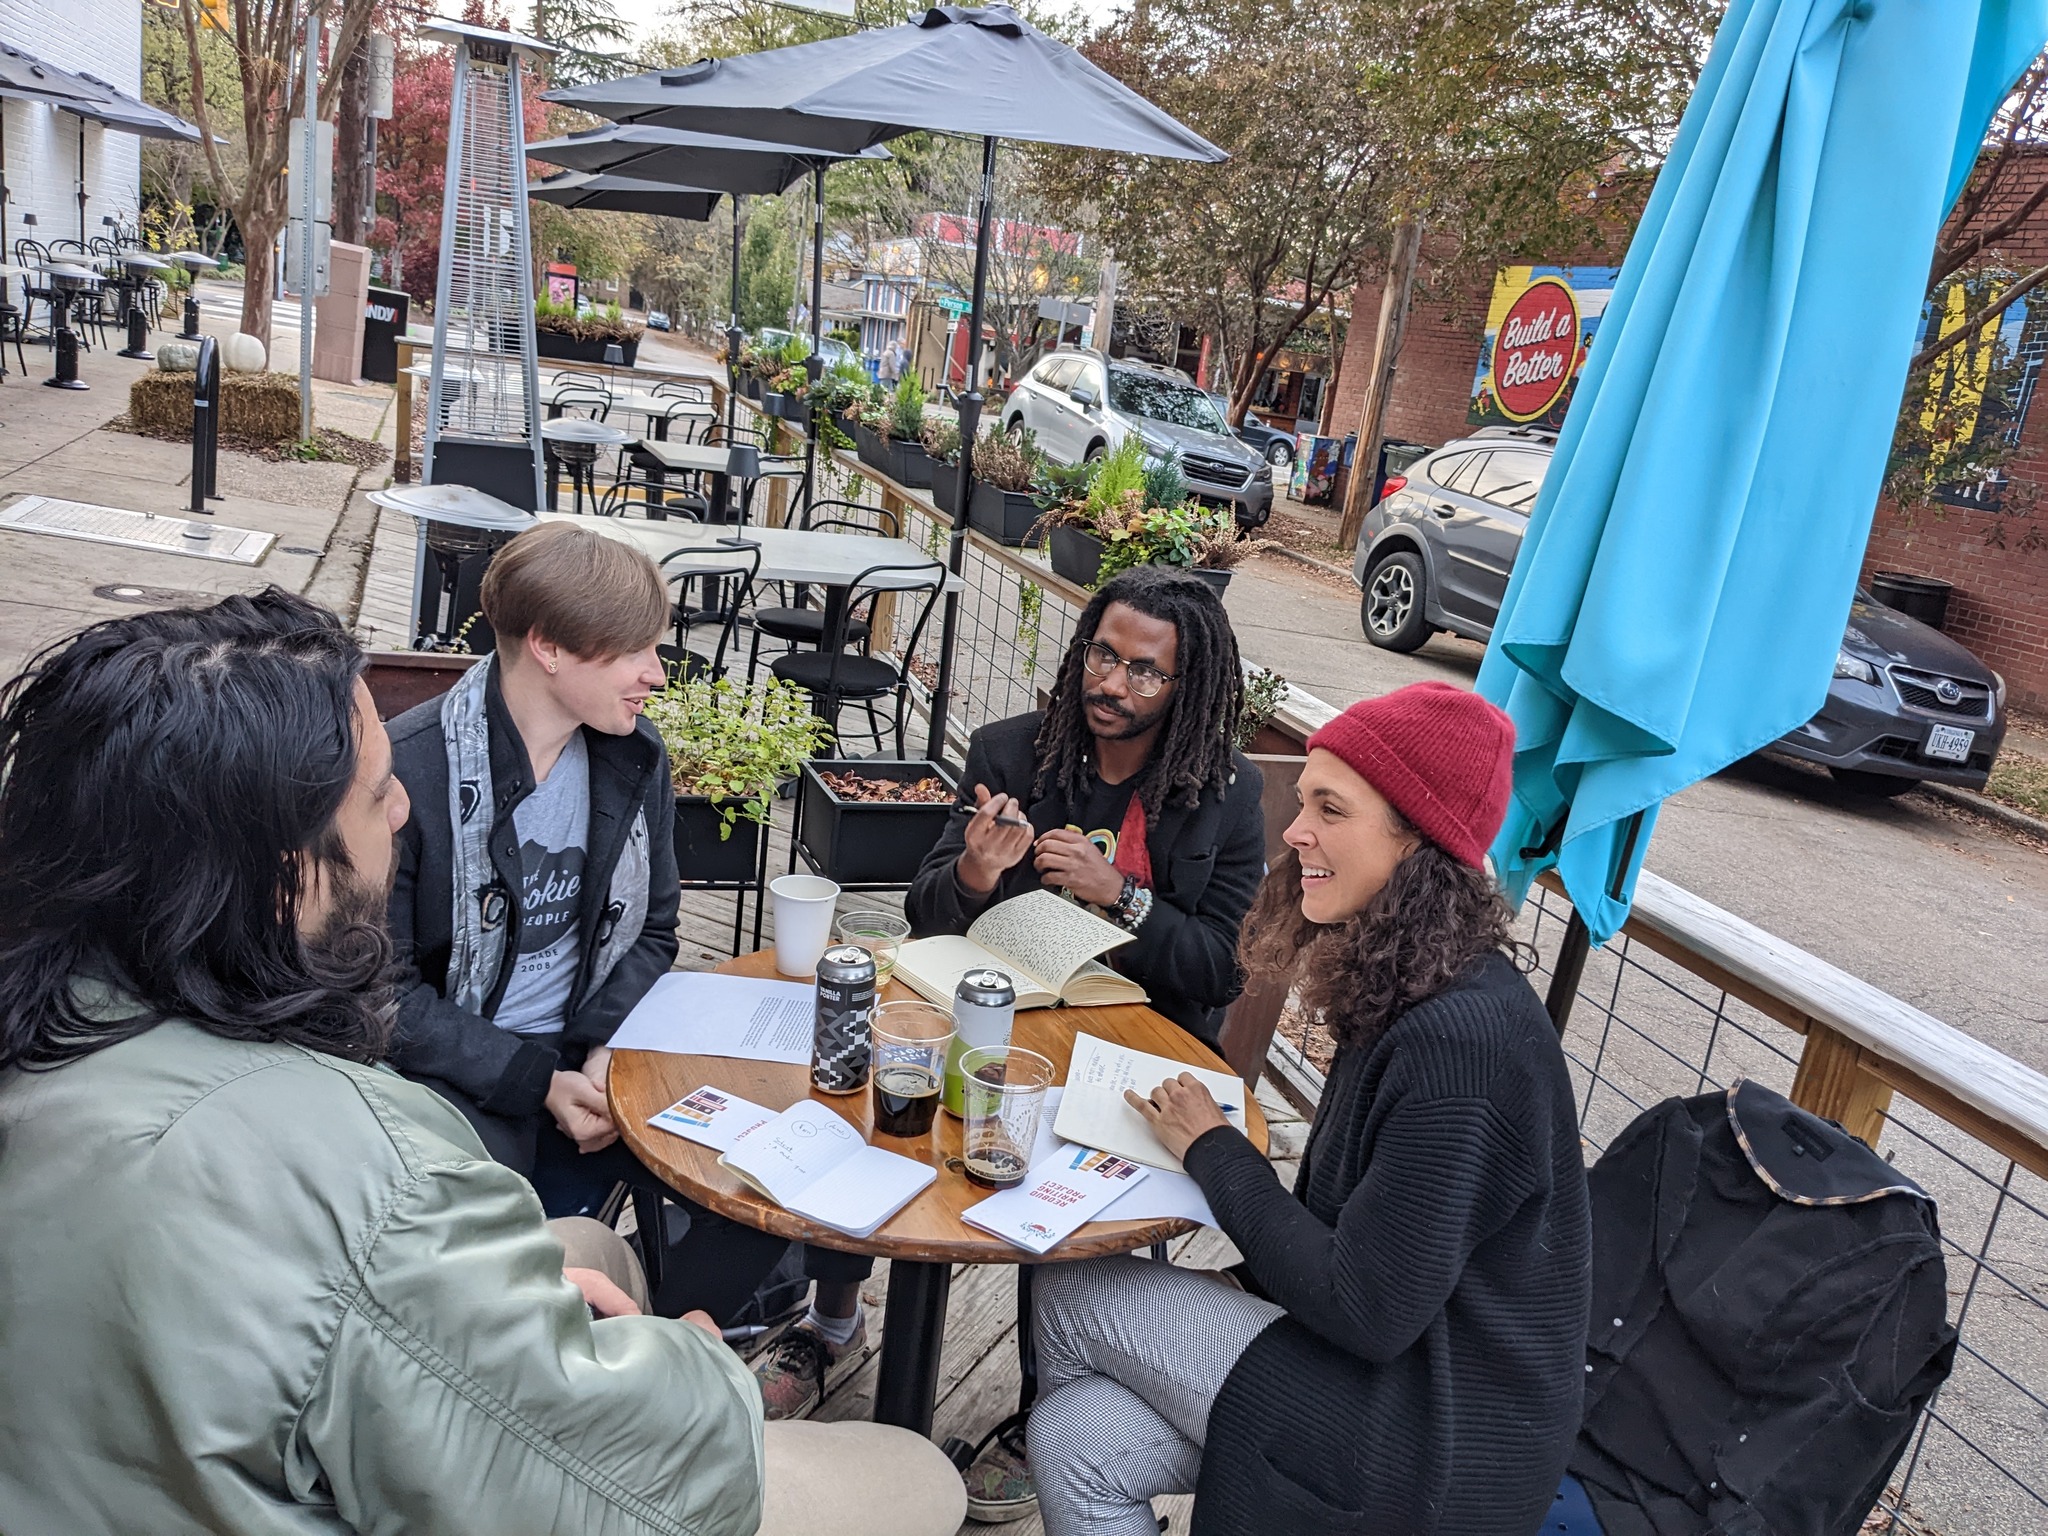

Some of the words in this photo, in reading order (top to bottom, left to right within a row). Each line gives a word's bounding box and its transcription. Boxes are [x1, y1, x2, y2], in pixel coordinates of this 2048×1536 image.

[1503, 307, 1557, 350] Build
[1555, 314, 1571, 338] a
[1502, 350, 1563, 388] Better
[1932, 733, 1969, 752] UKH-4959
[523, 869, 581, 910] okie
[521, 962, 551, 973] 2008
[820, 985, 841, 997] VANILLA
[820, 992, 841, 1002] PORTER
[1029, 1190, 1068, 1208] REDBUD
[1037, 1185, 1078, 1204] WRITING
[1043, 1180, 1087, 1200] PROJECT
